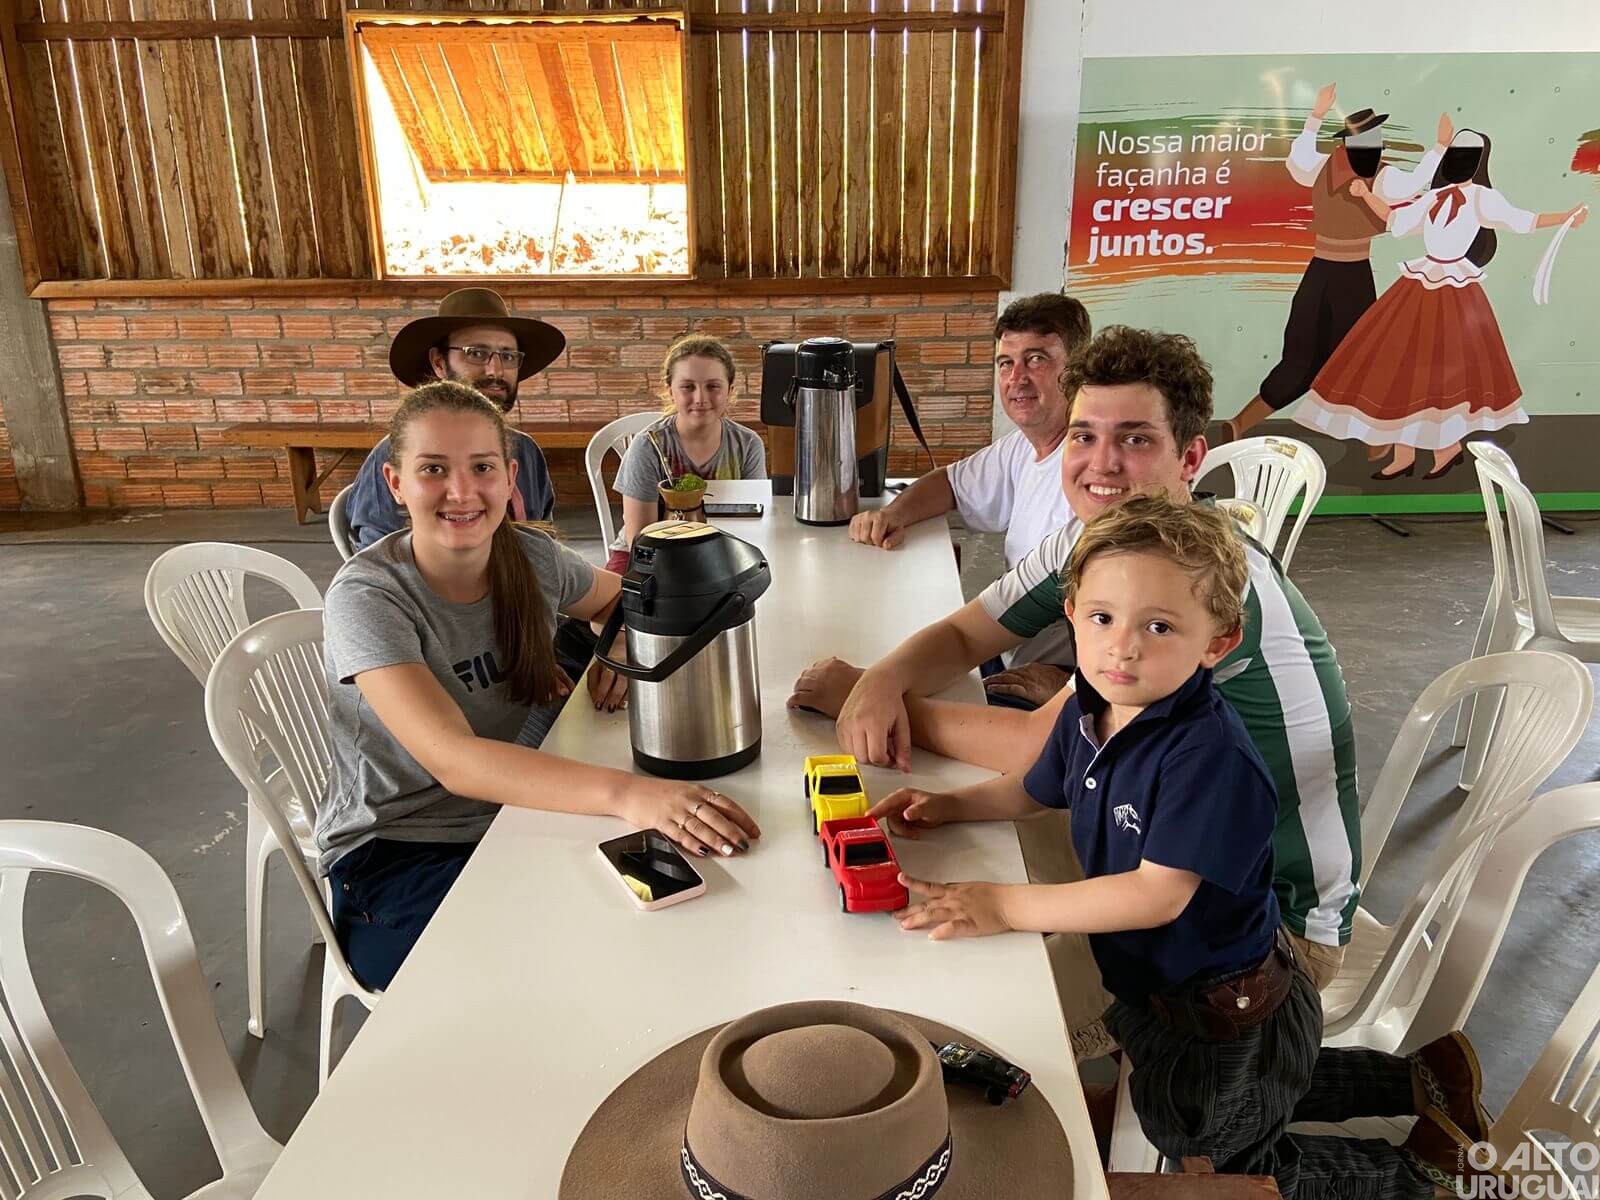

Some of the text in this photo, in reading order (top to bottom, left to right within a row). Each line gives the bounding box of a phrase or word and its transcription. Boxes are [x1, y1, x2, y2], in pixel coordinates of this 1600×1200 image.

[1097, 128, 1271, 155] Nossa maior
[1096, 160, 1231, 194] façanha é
[1093, 196, 1231, 222] crescer
[1087, 227, 1214, 264] juntos.
[452, 651, 505, 693] FIL
